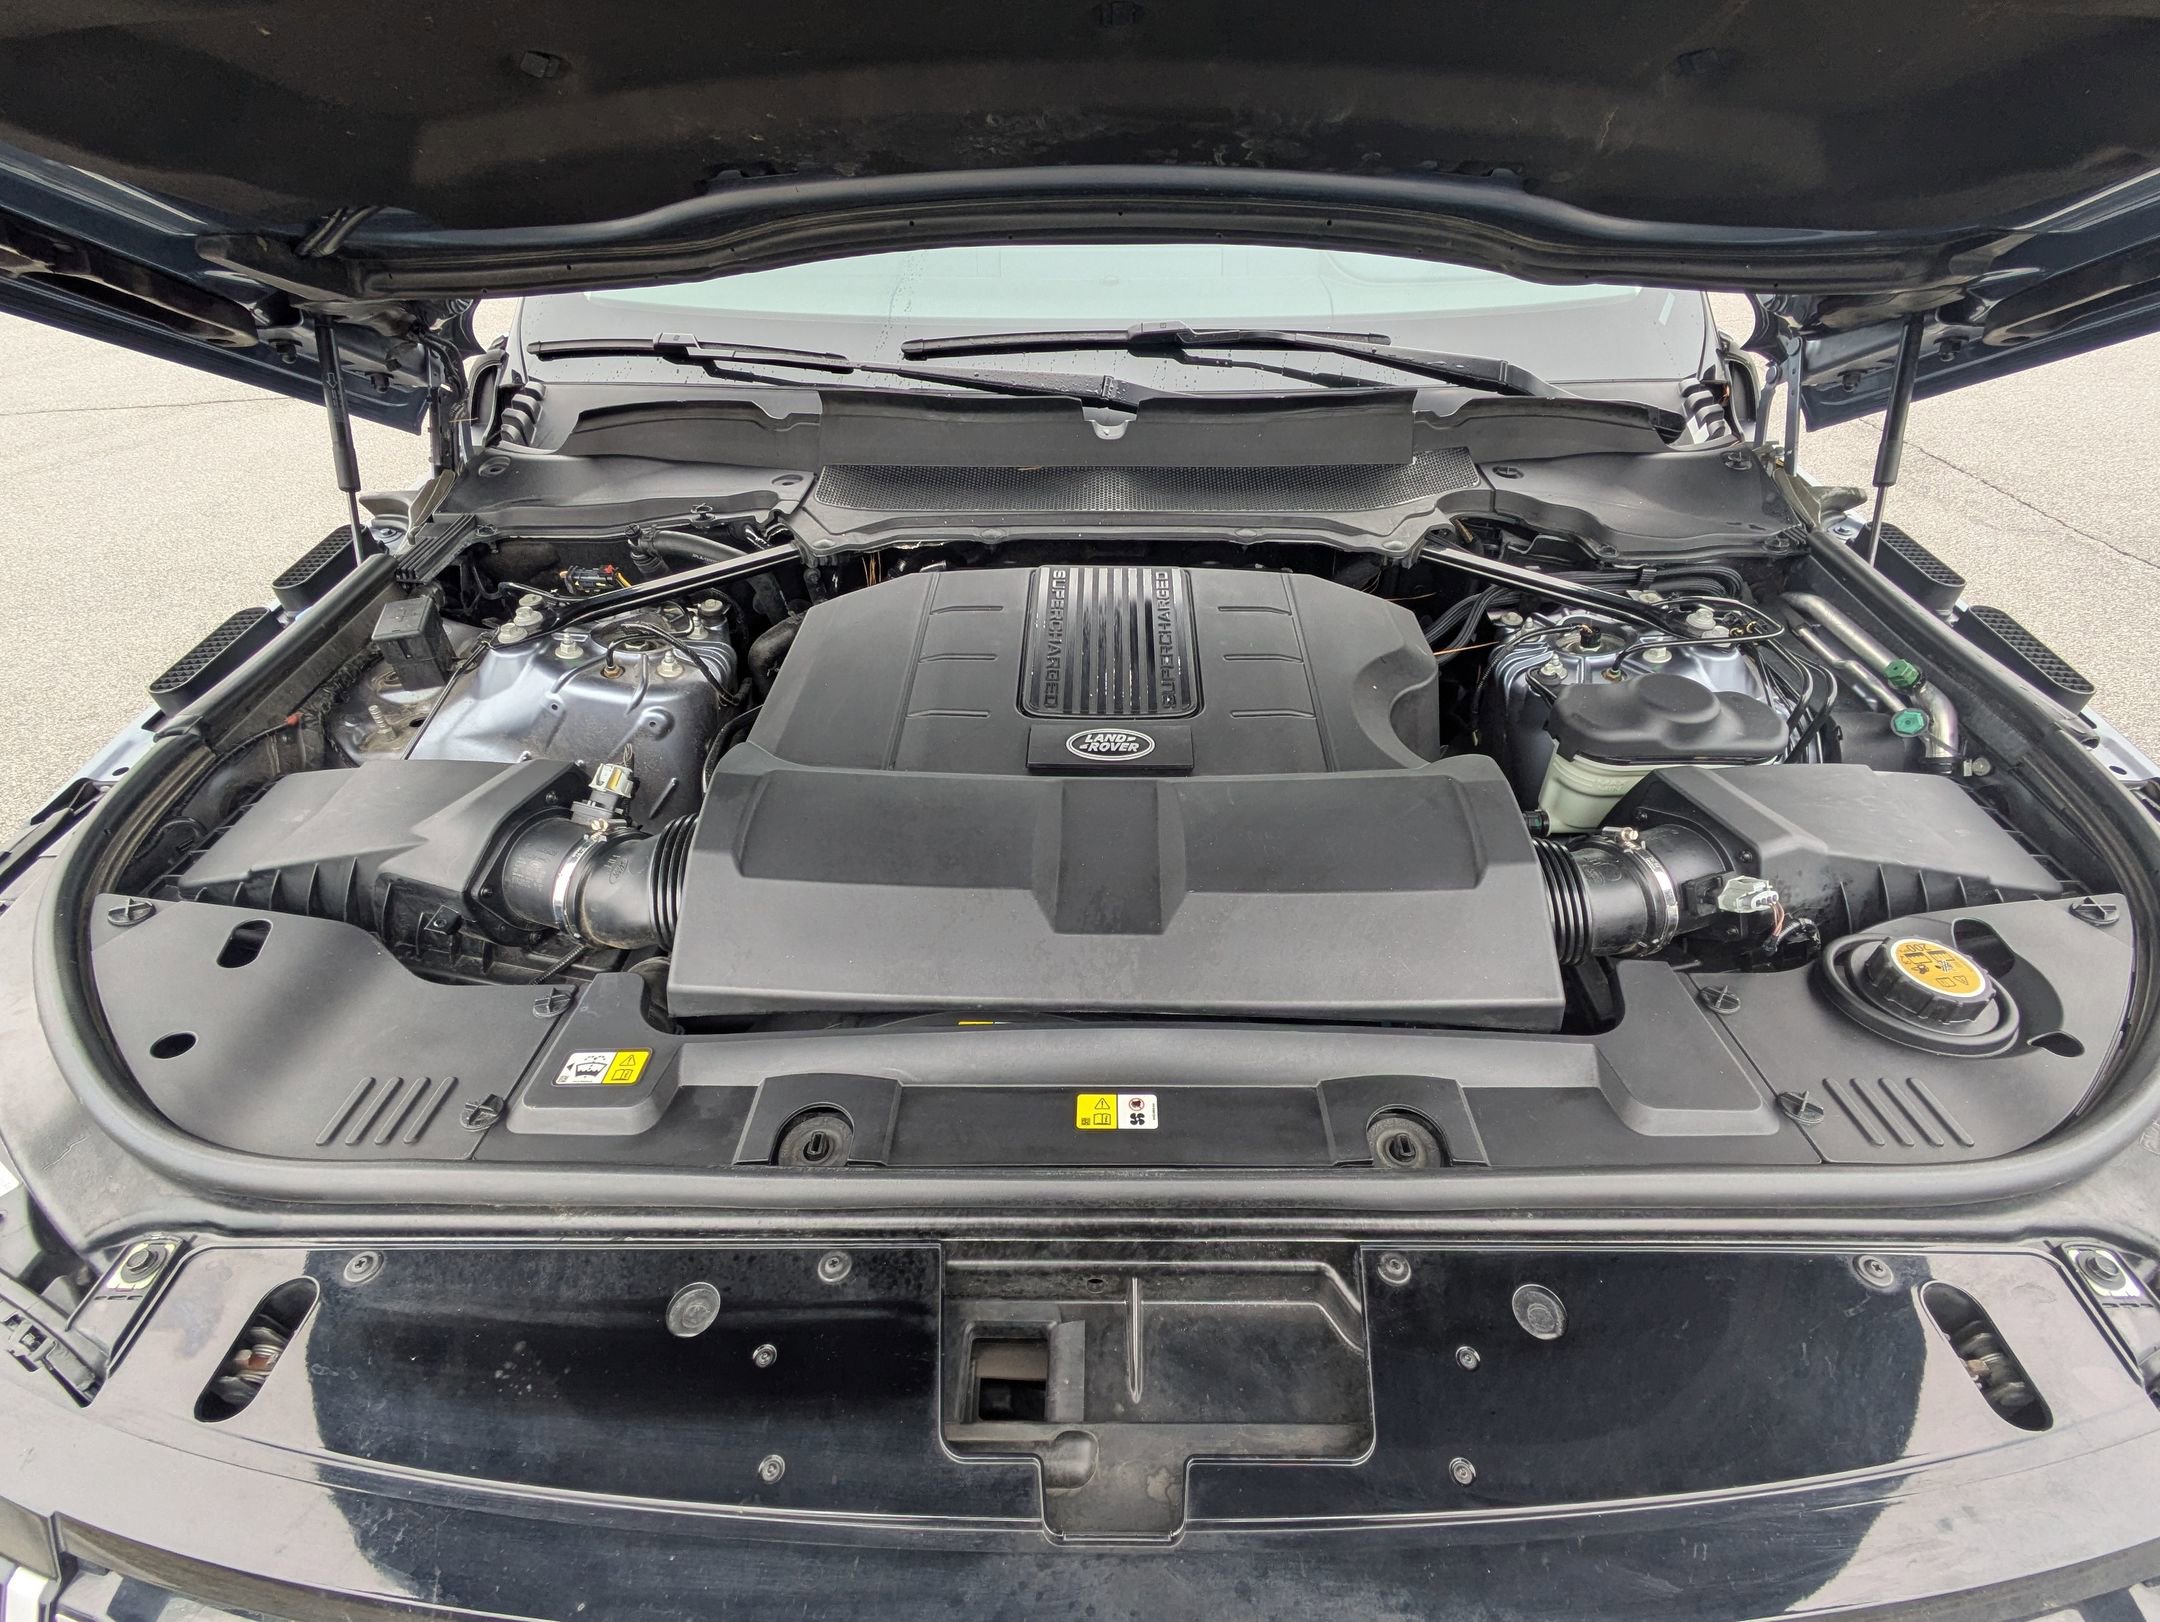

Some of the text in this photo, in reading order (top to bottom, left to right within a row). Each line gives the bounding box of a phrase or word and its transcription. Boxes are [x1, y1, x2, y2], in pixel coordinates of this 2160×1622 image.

[1043, 570, 1067, 709] SUPERCHARGED
[1155, 571, 1177, 711] SUPERCHARGED
[1083, 732, 1128, 743] LAND
[1086, 742, 1140, 753] ROVER
